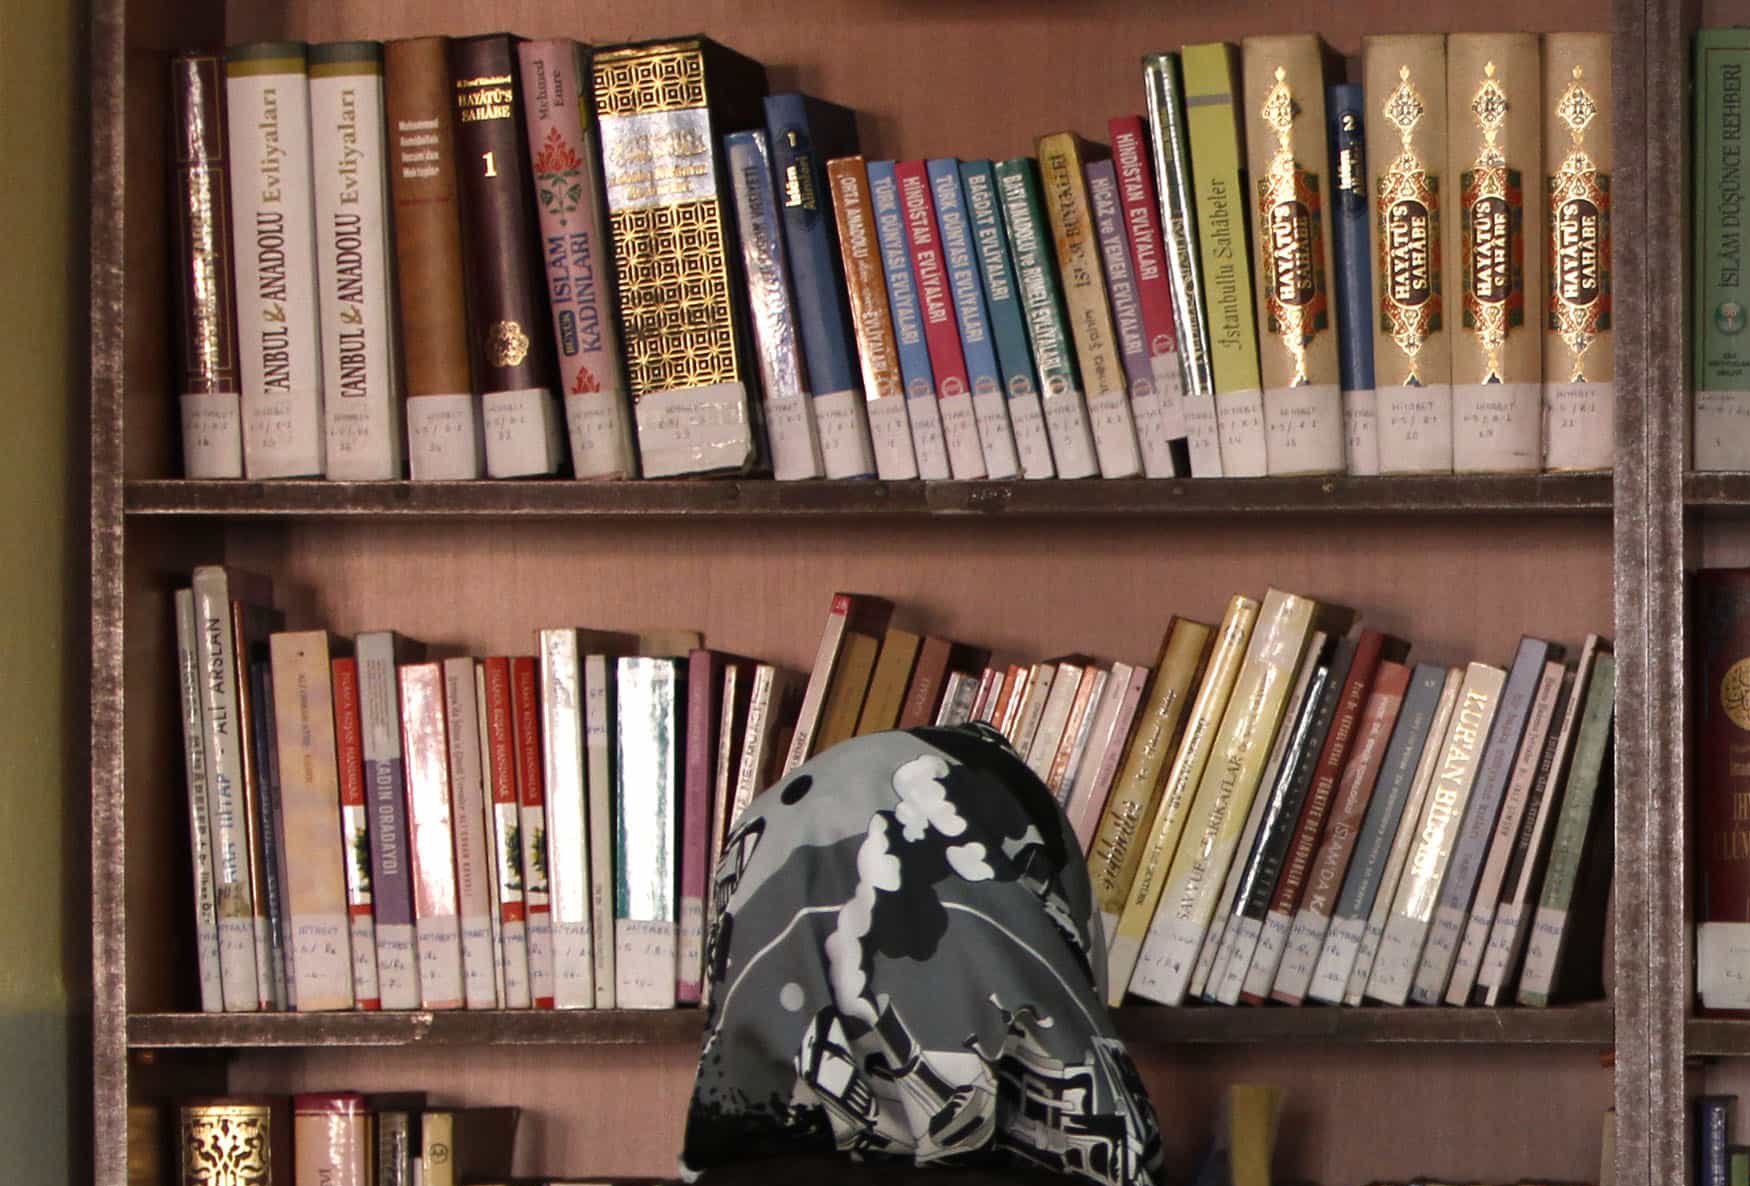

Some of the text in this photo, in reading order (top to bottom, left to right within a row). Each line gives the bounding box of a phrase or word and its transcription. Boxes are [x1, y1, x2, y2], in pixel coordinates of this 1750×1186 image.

[258, 88, 286, 203] Evliyaları
[1343, 115, 1354, 131] 2
[1718, 64, 1742, 145] REHBERİ
[334, 88, 365, 325] & ANADOLU Evliyaları
[481, 151, 498, 177] 1
[935, 174, 956, 210] TÜRK
[1116, 132, 1159, 281] HİNDİSTAN EVLİYALARI
[1718, 144, 1744, 224] DÜŞÜNCE
[256, 212, 286, 302] ANADOLU
[902, 175, 948, 324] HİNDİSTAN EVLİYALARI
[968, 174, 1010, 302] BAĞDAT EVLİYALARI
[264, 304, 285, 324] &
[571, 231, 603, 353] KADINLARI
[1217, 264, 1244, 351] İstanbullu
[206, 617, 225, 695] ARSLAN
[208, 704, 228, 736] ALİ
[1440, 688, 1488, 786] KUR'AN
